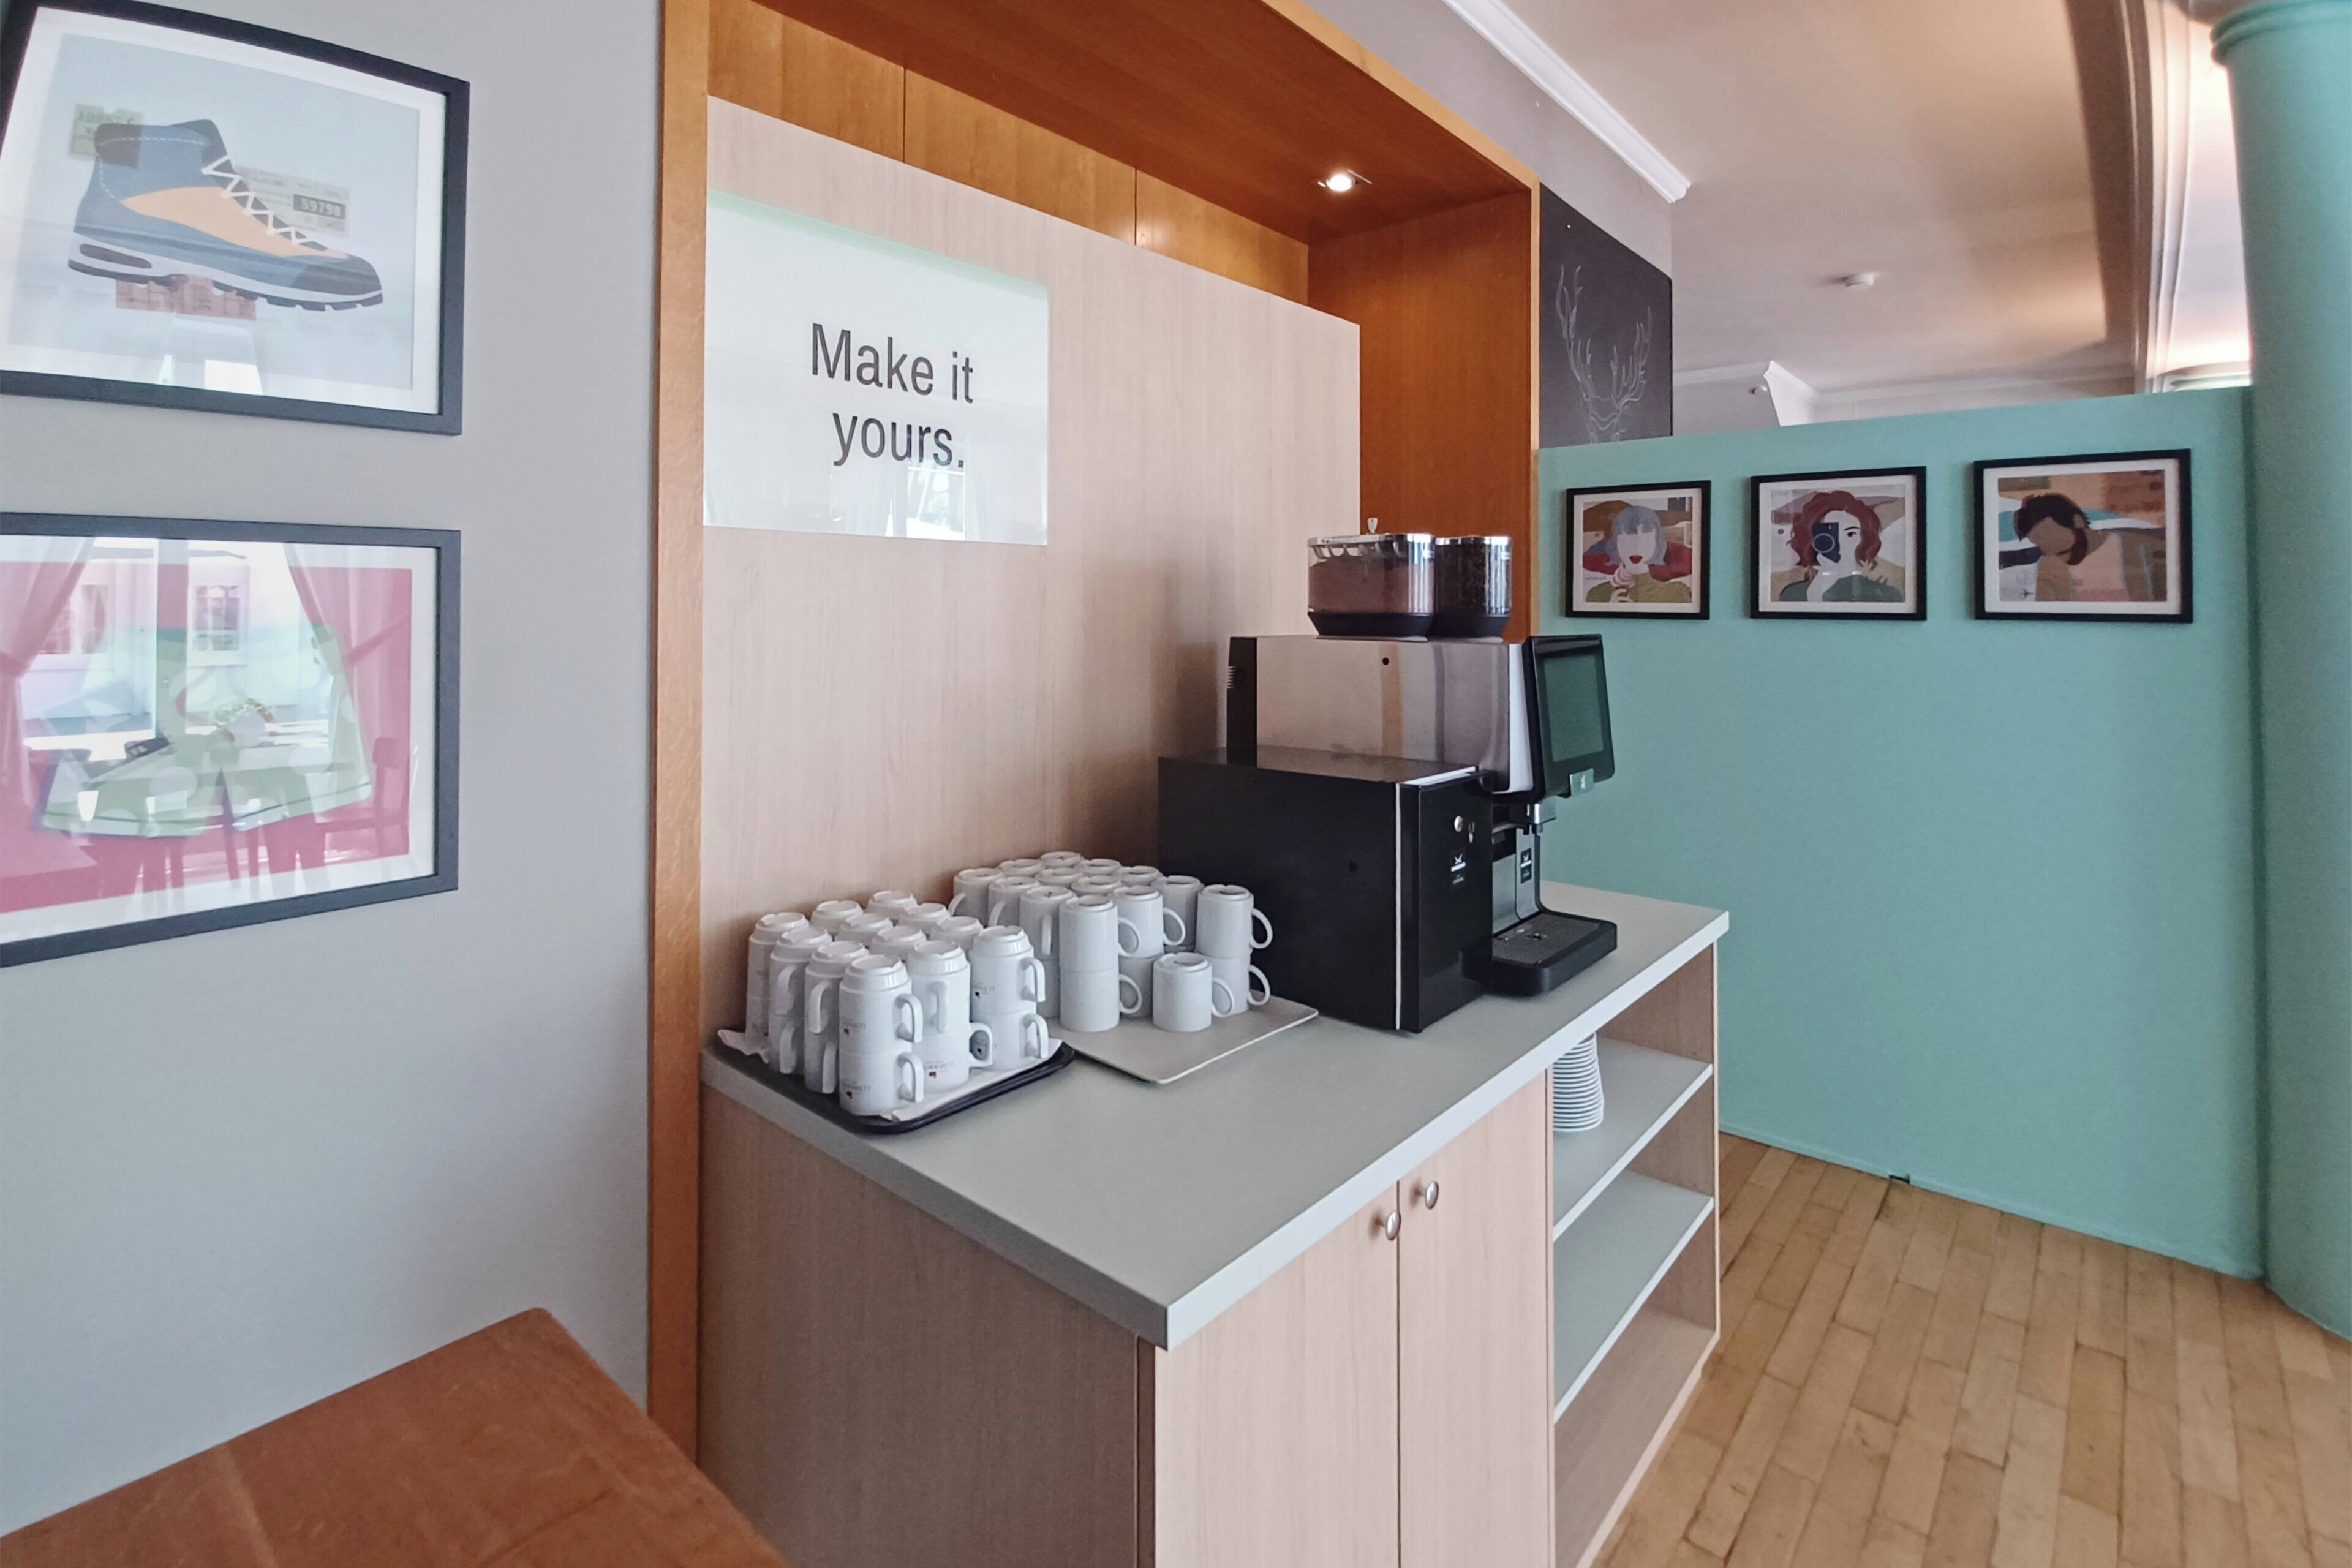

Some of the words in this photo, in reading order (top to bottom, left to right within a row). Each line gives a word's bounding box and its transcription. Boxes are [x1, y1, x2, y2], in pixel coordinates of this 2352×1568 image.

[812, 323, 934, 396] Make
[952, 351, 973, 404] it
[832, 412, 964, 468] yours.
